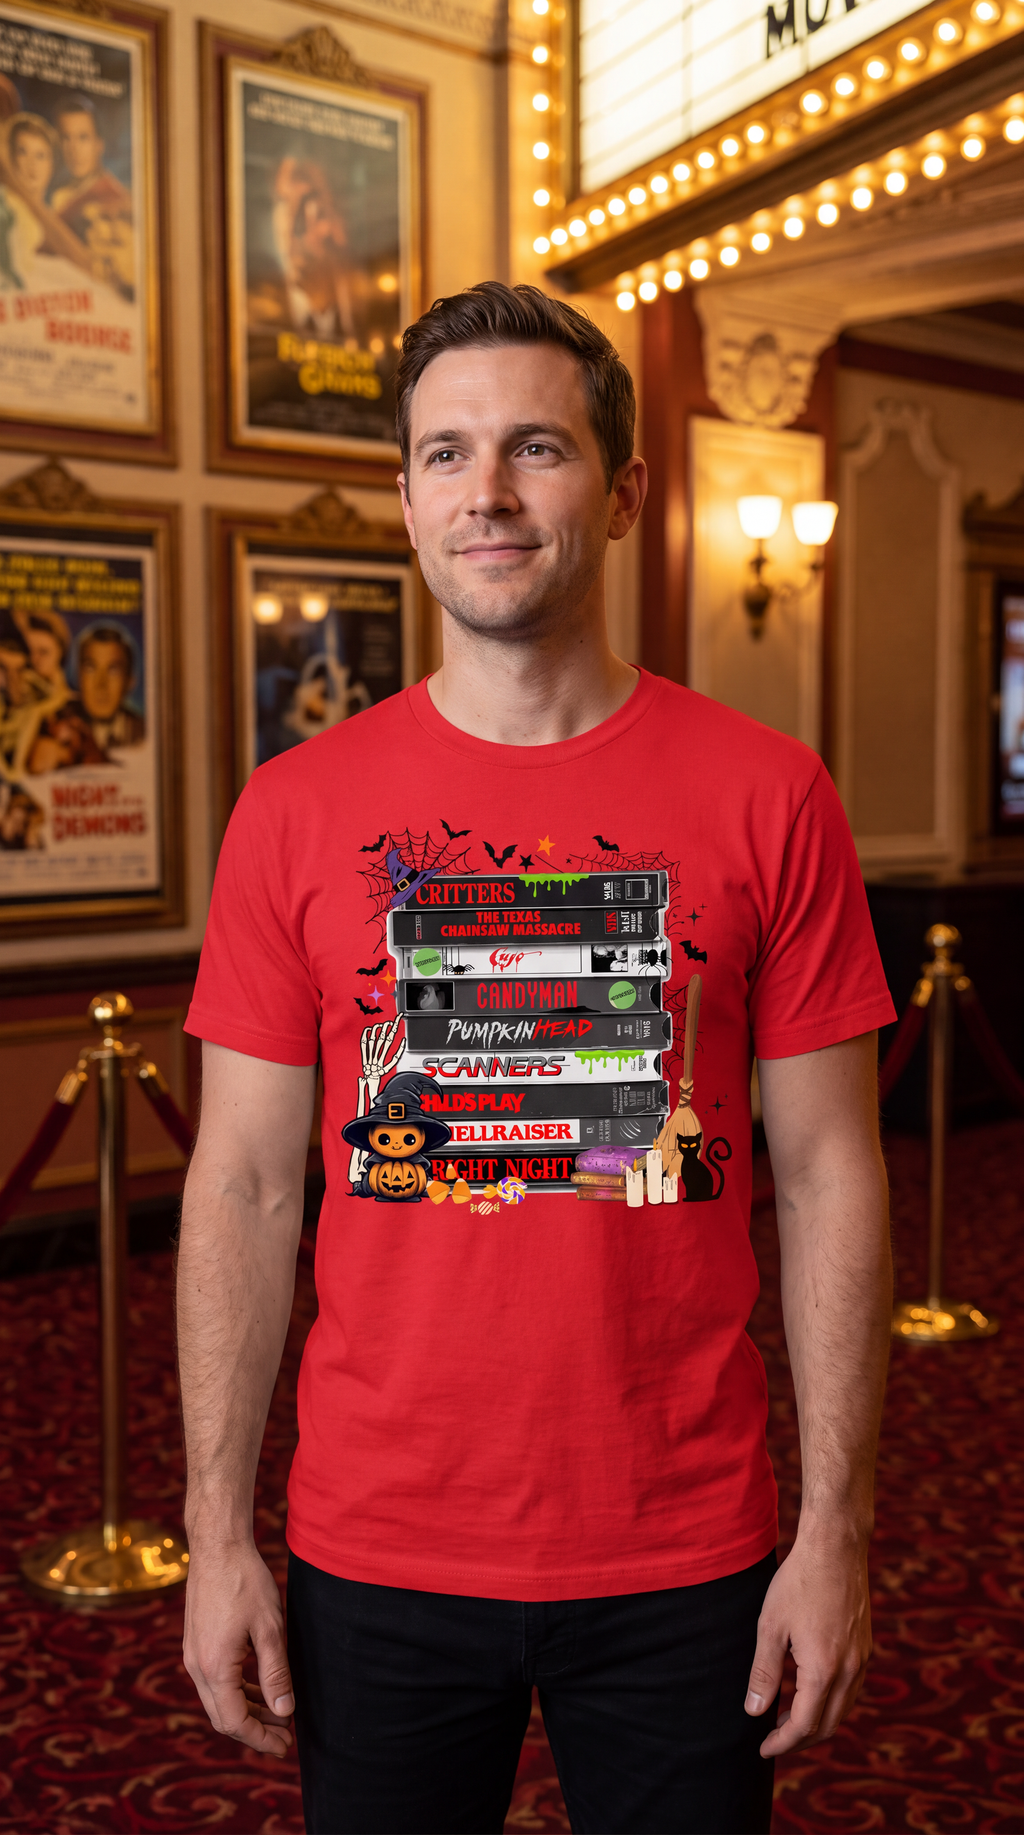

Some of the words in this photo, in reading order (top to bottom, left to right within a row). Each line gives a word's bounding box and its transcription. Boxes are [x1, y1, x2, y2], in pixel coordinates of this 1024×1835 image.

[415, 882, 516, 905] CRITTERS
[476, 911, 500, 924] THE
[502, 910, 541, 923] TEXAS
[440, 925, 510, 937] CHAINSAW
[513, 922, 581, 936] MASSACRE
[477, 981, 578, 1009] CANDYMAN
[422, 1056, 566, 1078] SCANNERS
[478, 1093, 526, 1114] PLAY
[504, 1157, 573, 1181] NIGHT
